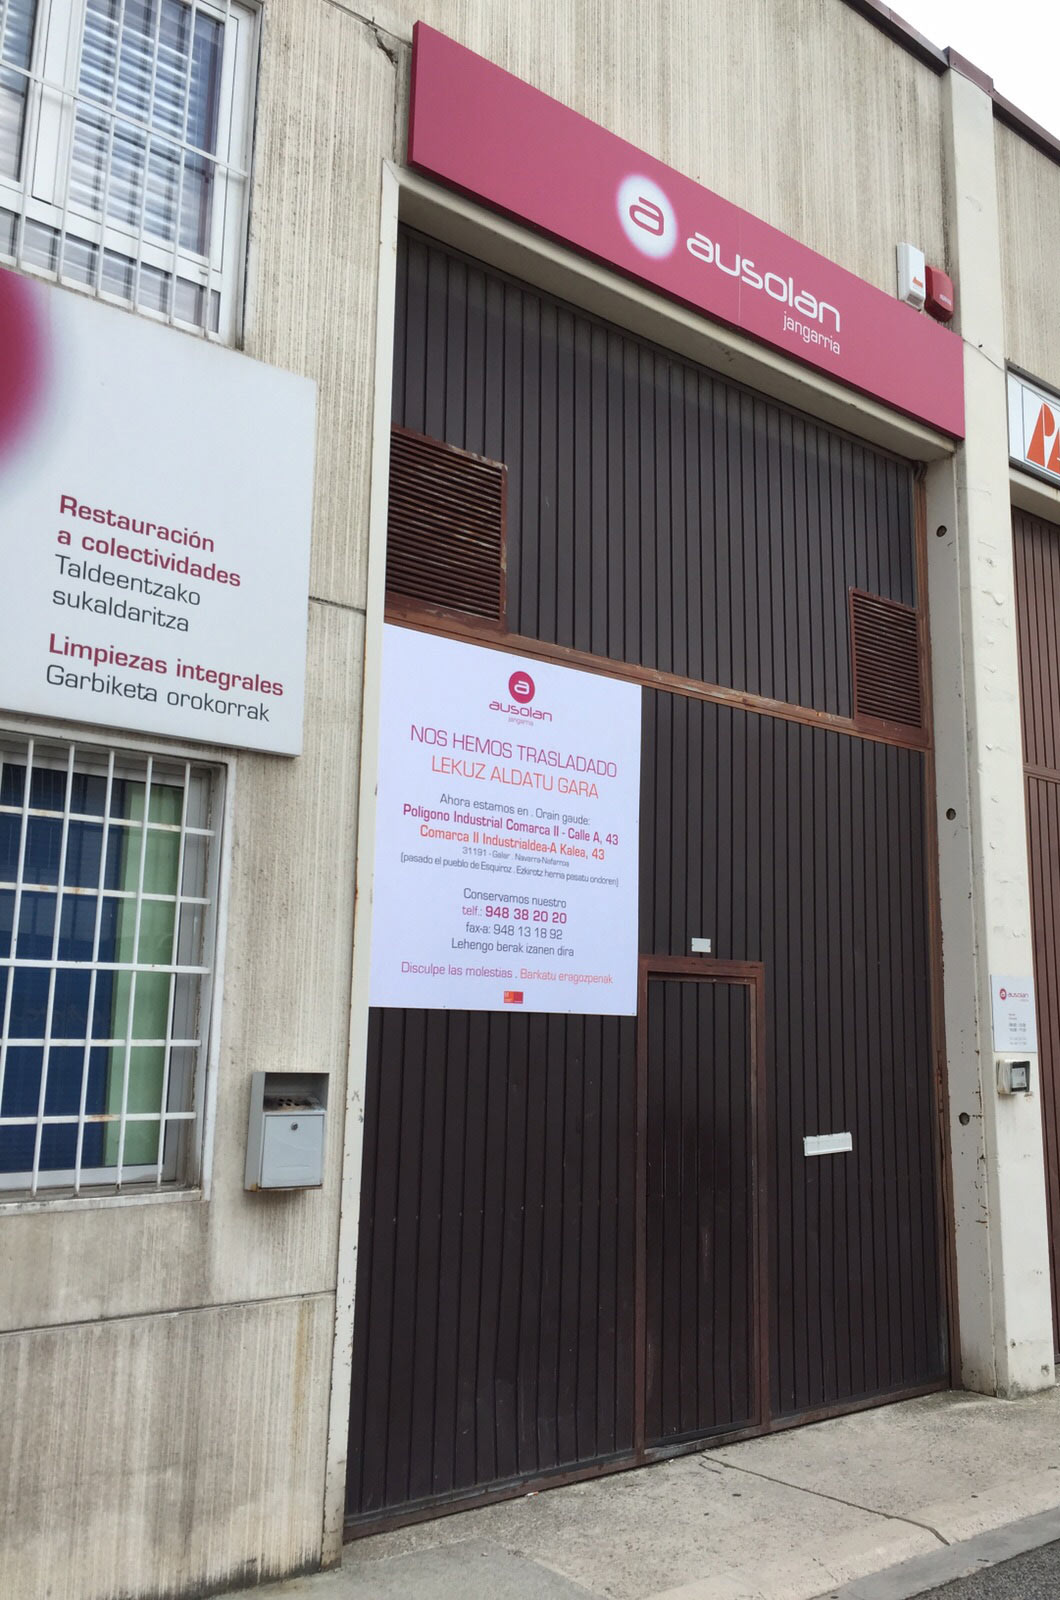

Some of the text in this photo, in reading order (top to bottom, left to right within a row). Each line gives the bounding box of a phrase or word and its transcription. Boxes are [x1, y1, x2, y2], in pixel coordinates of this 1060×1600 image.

[686, 231, 840, 333] ausolan
[783, 311, 840, 355] jangarria
[59, 494, 215, 553] Restauración
[57, 529, 241, 587] a colectividades
[55, 553, 201, 606] Taldeentzako
[52, 589, 189, 632] sukaldaritza
[49, 633, 284, 697] Limpiezas integrales
[46, 664, 270, 722] Garbiketa orokorrak
[489, 700, 553, 722] ausolan
[411, 724, 617, 778] NOS HEMOS TRASLADADO
[432, 755, 599, 799] LEKUZ ALDATU GARA
[440, 793, 471, 808] Ahora
[473, 800, 515, 815] estamos
[517, 807, 529, 816] en
[535, 807, 560, 821] Orain
[562, 814, 590, 826] gaude:
[420, 824, 605, 860] Comarca II Industrialdea-A Kalea, 43
[454, 810, 503, 829] Industrial
[506, 818, 551, 836] Comarca
[553, 825, 559, 837] II
[567, 827, 591, 842] Calle
[593, 831, 603, 845] A,
[605, 833, 619, 846] 43
[435, 857, 442, 865] el
[443, 859, 469, 869] pueblo
[470, 860, 480, 870] de
[481, 861, 512, 873] Esquiroz
[462, 846, 487, 857] 31191
[463, 887, 567, 909] Conservamos nuestro
[485, 905, 510, 919] 948
[513, 908, 529, 920] 38
[533, 910, 549, 922] 20
[552, 912, 567, 924] 20
[451, 937, 575, 957] Lehengo berak izanen dira
[466, 922, 563, 940] fax-a: 948 13 18 92
[401, 961, 446, 977] Disculpe
[448, 963, 463, 976] las
[465, 965, 513, 978] molestias
[520, 967, 557, 981] Barkatu
[558, 971, 614, 985] eragozpenak
